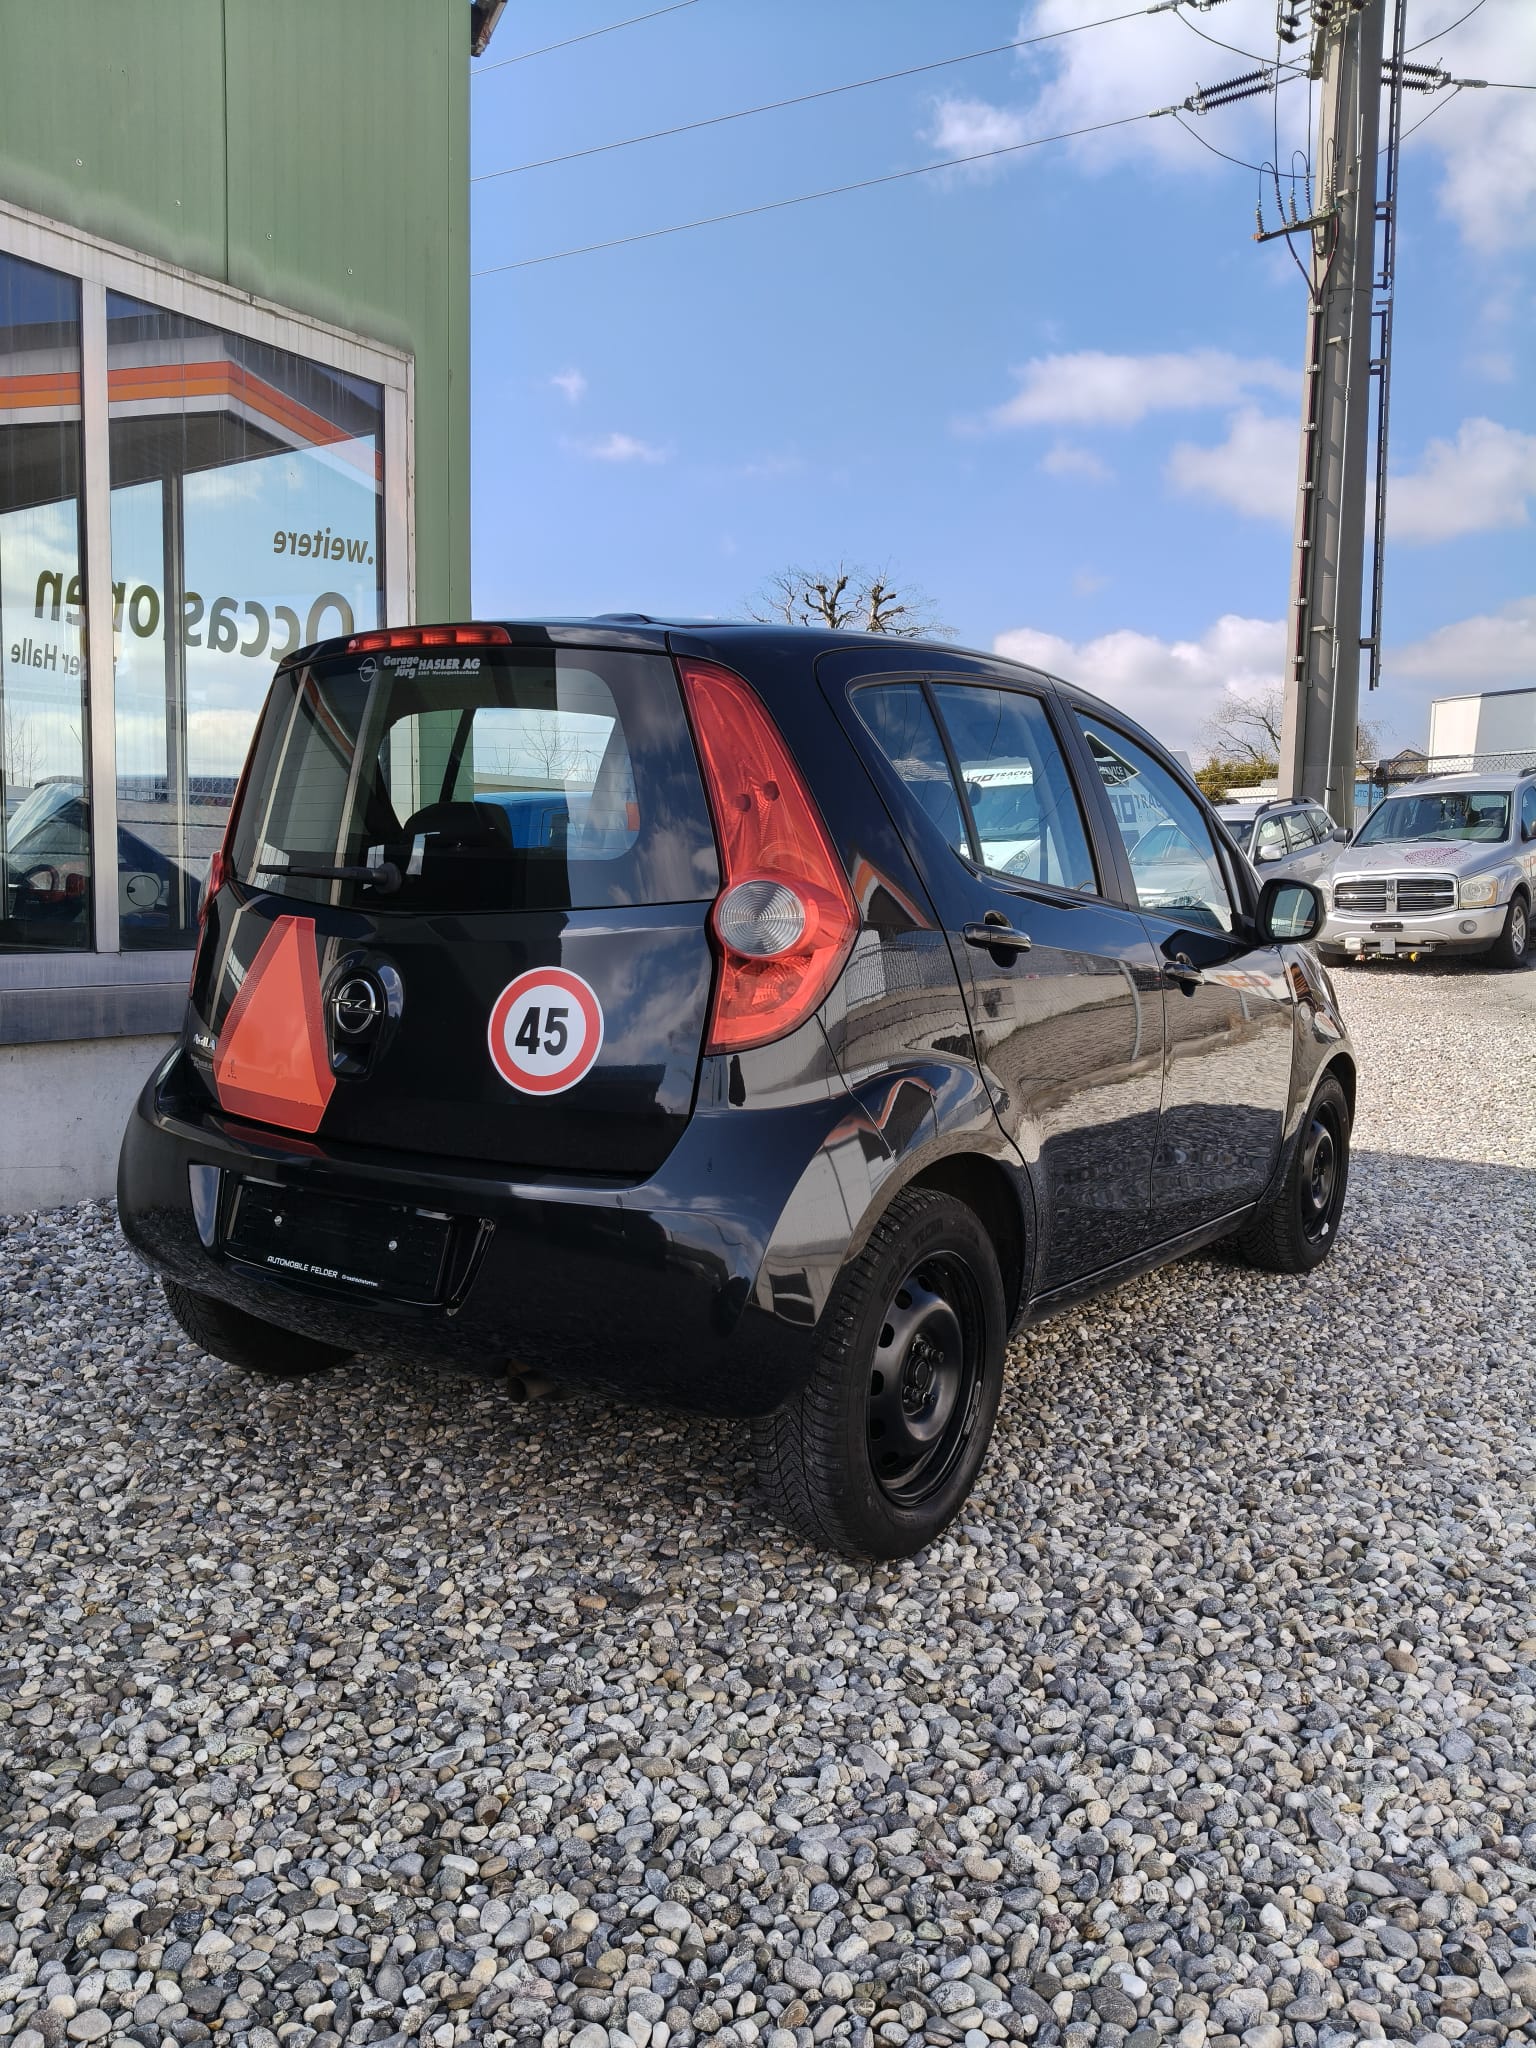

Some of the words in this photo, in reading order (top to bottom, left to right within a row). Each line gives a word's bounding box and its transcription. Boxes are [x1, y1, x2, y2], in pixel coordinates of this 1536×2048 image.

[383, 656, 420, 667] Garage
[419, 658, 460, 670] HASLER
[463, 658, 480, 669] AG
[394, 665, 416, 679] Jürg
[515, 1007, 568, 1056] 45
[267, 1256, 309, 1271] AUTOMOBILE
[310, 1265, 338, 1278] FELDER
